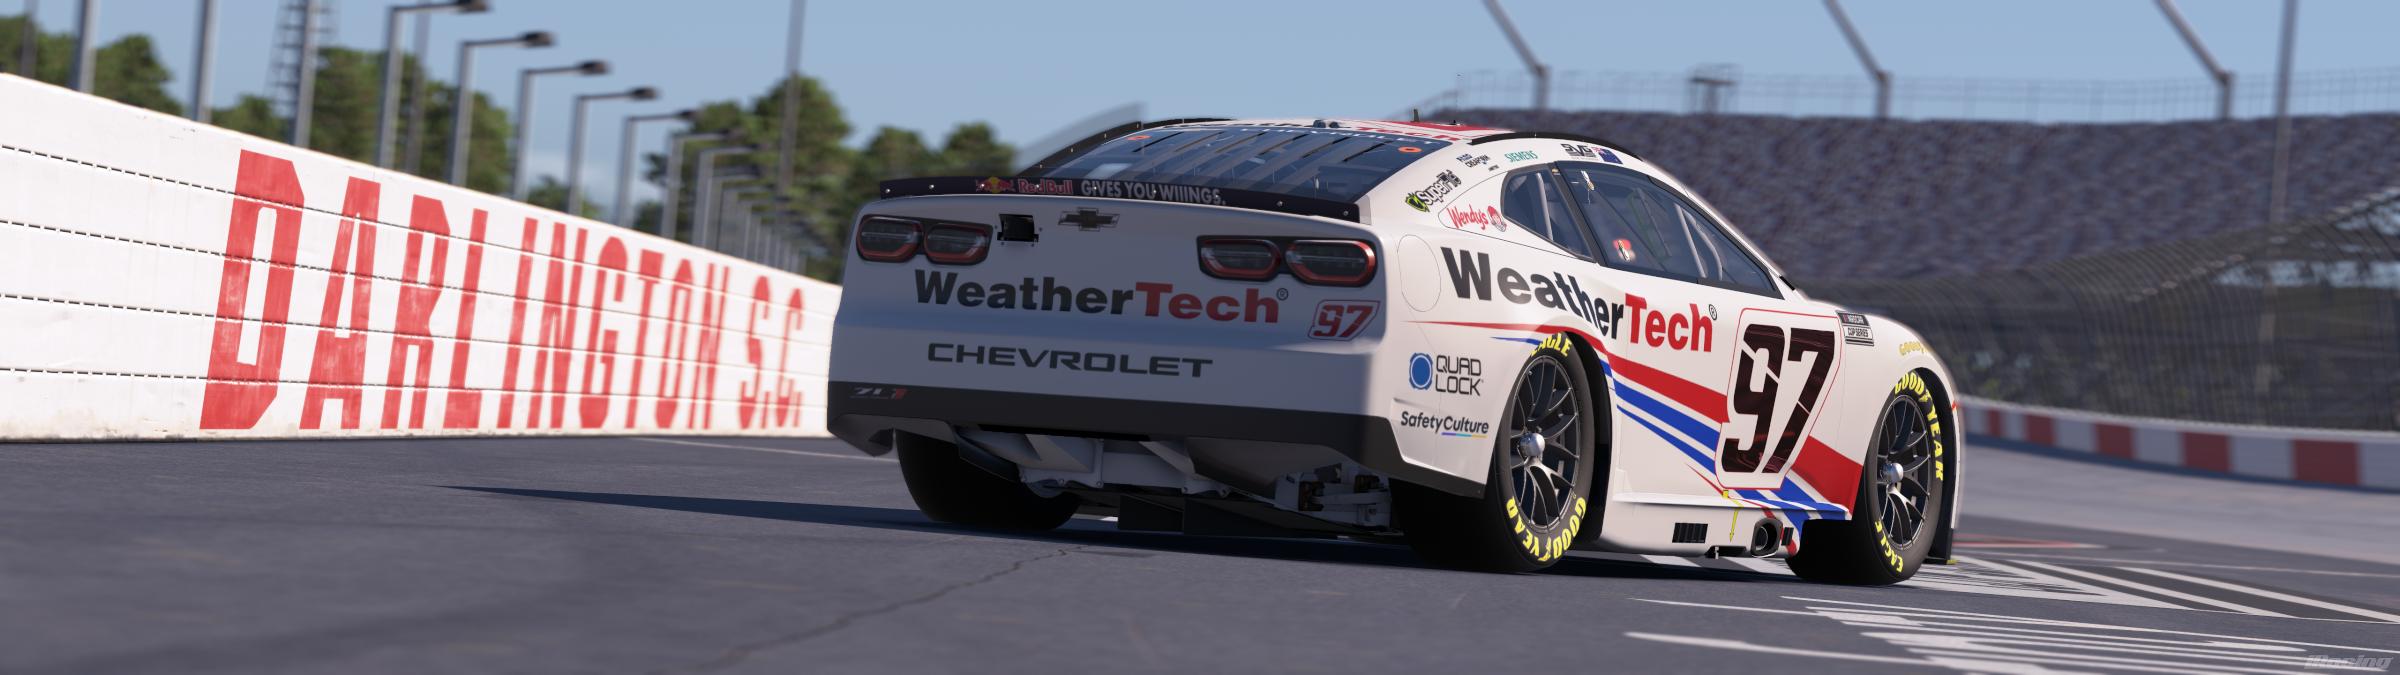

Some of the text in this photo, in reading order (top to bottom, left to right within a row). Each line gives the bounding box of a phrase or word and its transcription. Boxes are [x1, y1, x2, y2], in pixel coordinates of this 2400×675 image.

[1504, 150, 1539, 163] SIEMENS
[1018, 178, 1045, 195] Red
[1046, 179, 1073, 196] Bull
[1081, 179, 1121, 199] GIVES
[1124, 182, 1156, 201] YOU
[1446, 204, 1489, 230] Wendy's
[200, 149, 804, 430] DARLINGTON S.C.
[1312, 304, 1373, 337] 97
[928, 342, 1213, 378] CHEVROLET
[1436, 355, 1481, 376] QUAD
[1435, 374, 1481, 396] LOCK
[1721, 323, 1835, 473] 97
[1401, 411, 1489, 434] SafetyCulture
[1894, 372, 1944, 481] GOODYEAR
